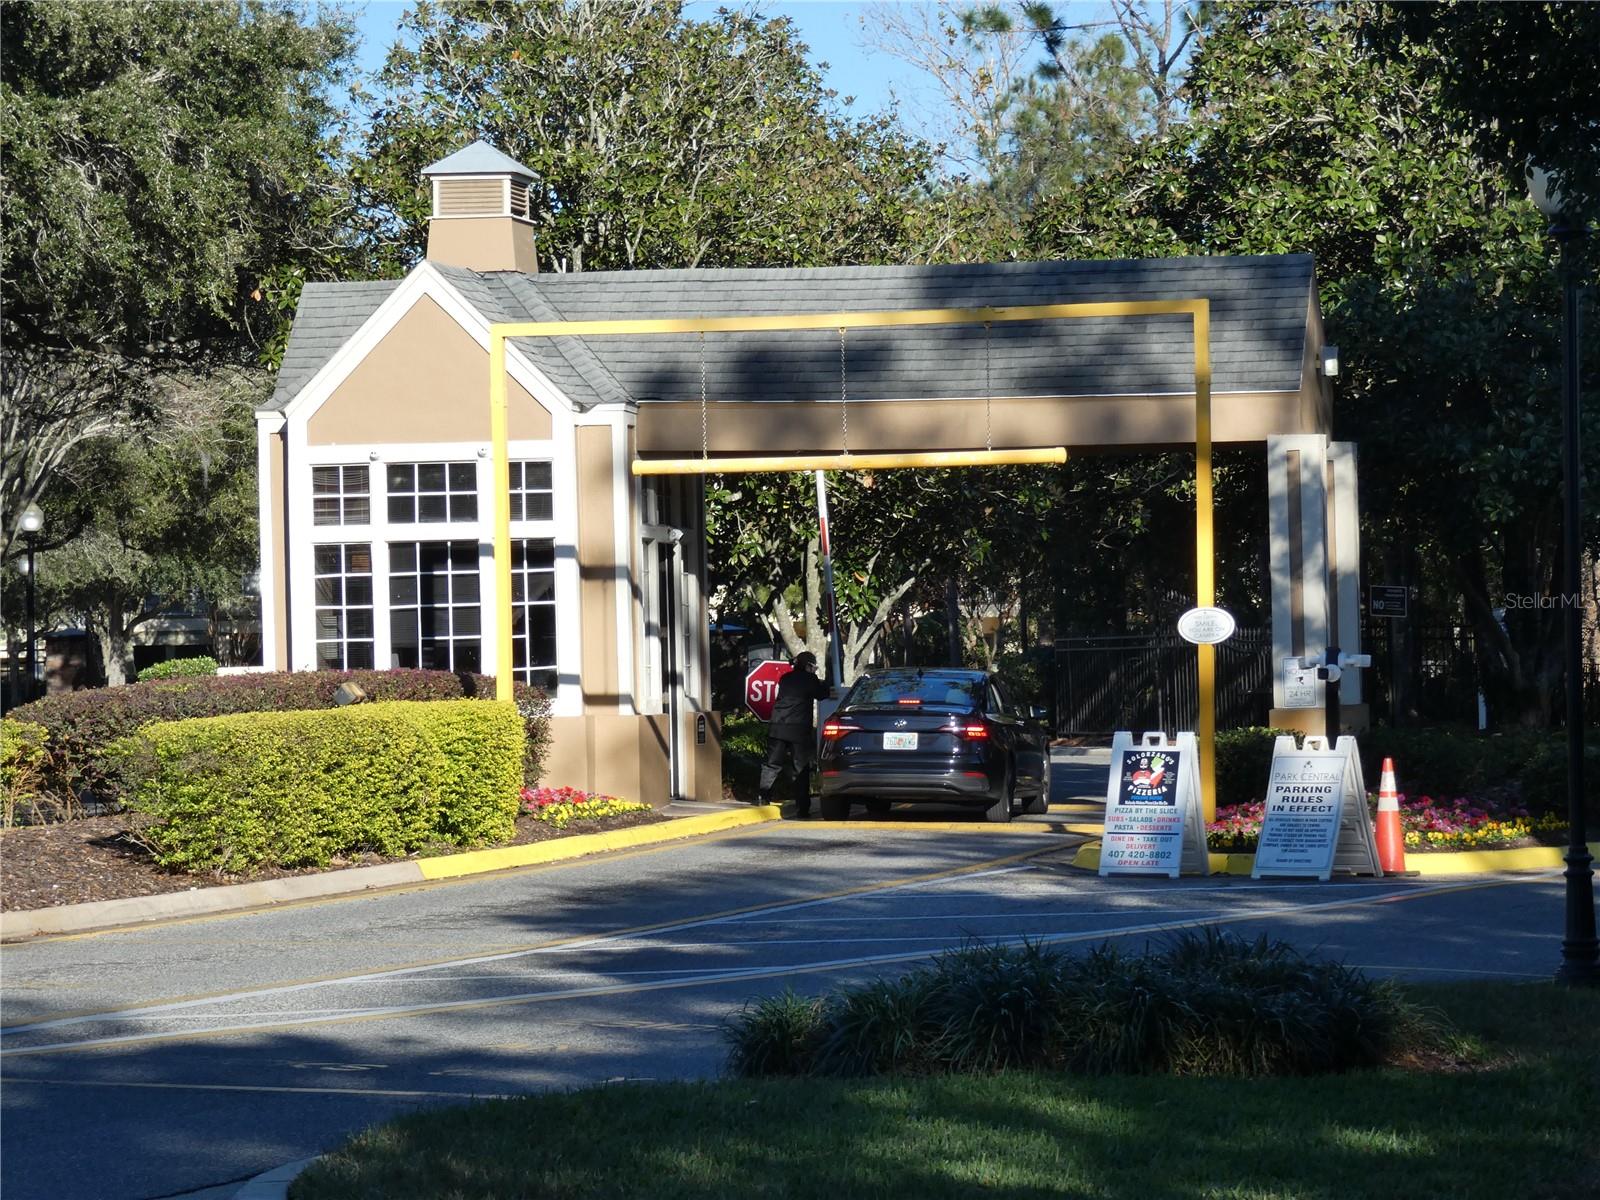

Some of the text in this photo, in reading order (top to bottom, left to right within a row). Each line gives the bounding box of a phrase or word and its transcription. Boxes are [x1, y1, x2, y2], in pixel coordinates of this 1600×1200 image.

[1373, 600, 1384, 610] NO
[750, 680, 779, 702] ST
[1274, 772, 1340, 781] PARK CENTRAL
[1127, 785, 1168, 796] PIZZERIA
[1108, 850, 1125, 858] 407
